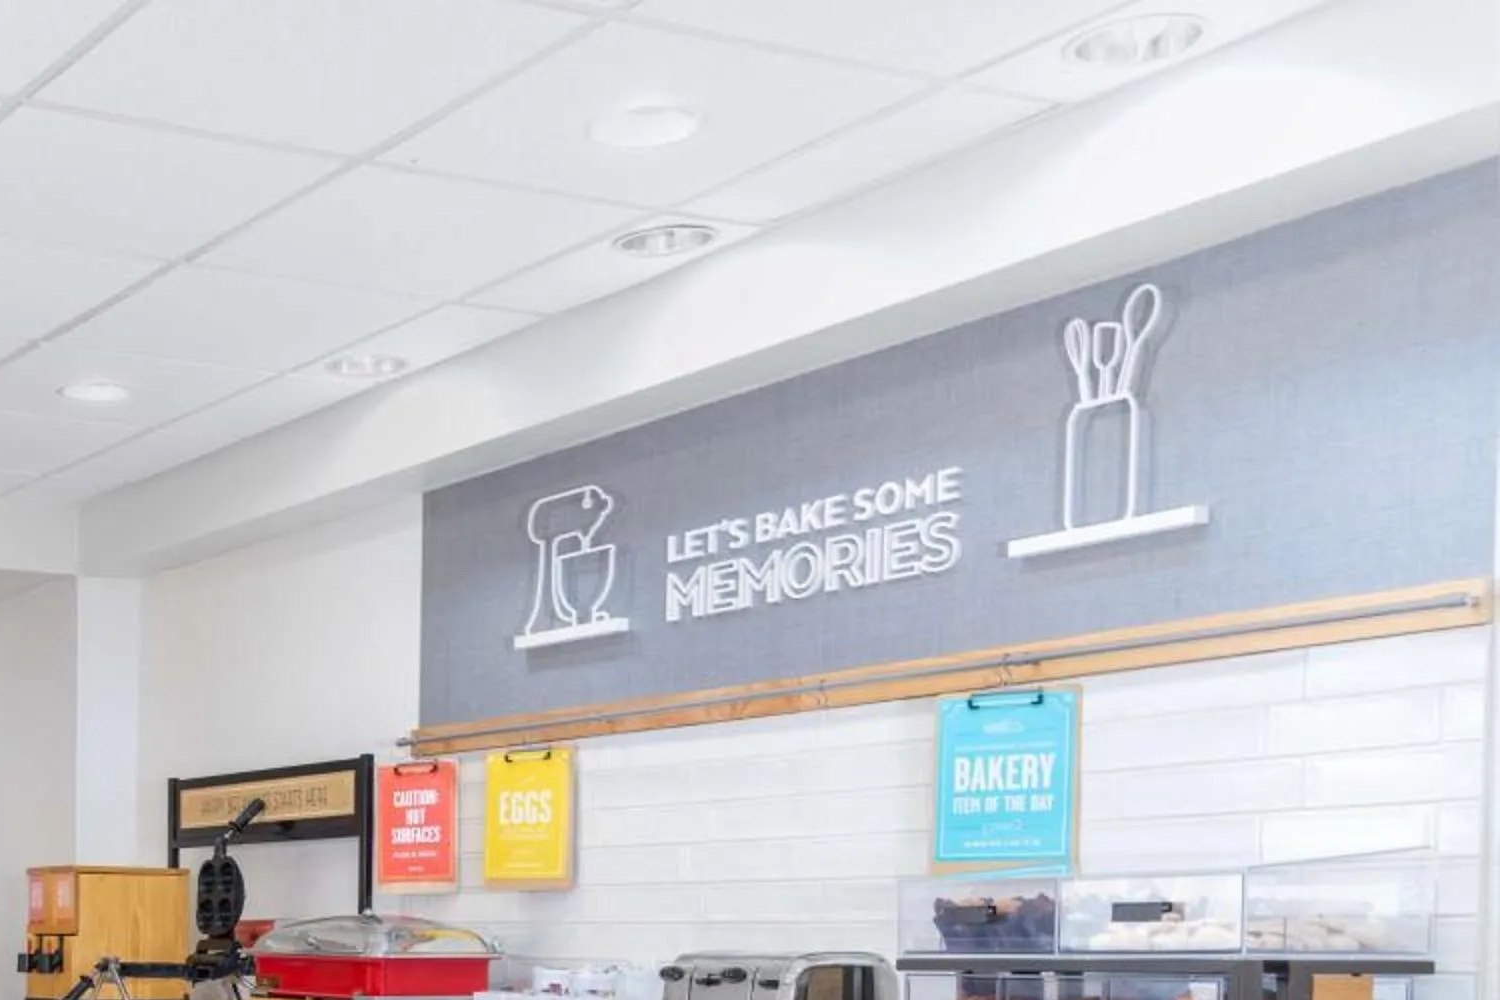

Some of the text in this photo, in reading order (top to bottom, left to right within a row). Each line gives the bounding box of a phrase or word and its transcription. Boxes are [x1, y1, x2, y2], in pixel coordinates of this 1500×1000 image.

[667, 465, 964, 563] LET'S BAKE SOME
[665, 511, 963, 622] MEMORIES
[953, 752, 1057, 793] BAKERY
[499, 789, 552, 825] EGGS
[952, 797, 981, 816] ITEM
[984, 796, 999, 813] OF
[1004, 795, 1026, 812] THE
[391, 826, 442, 845] SURFACES
